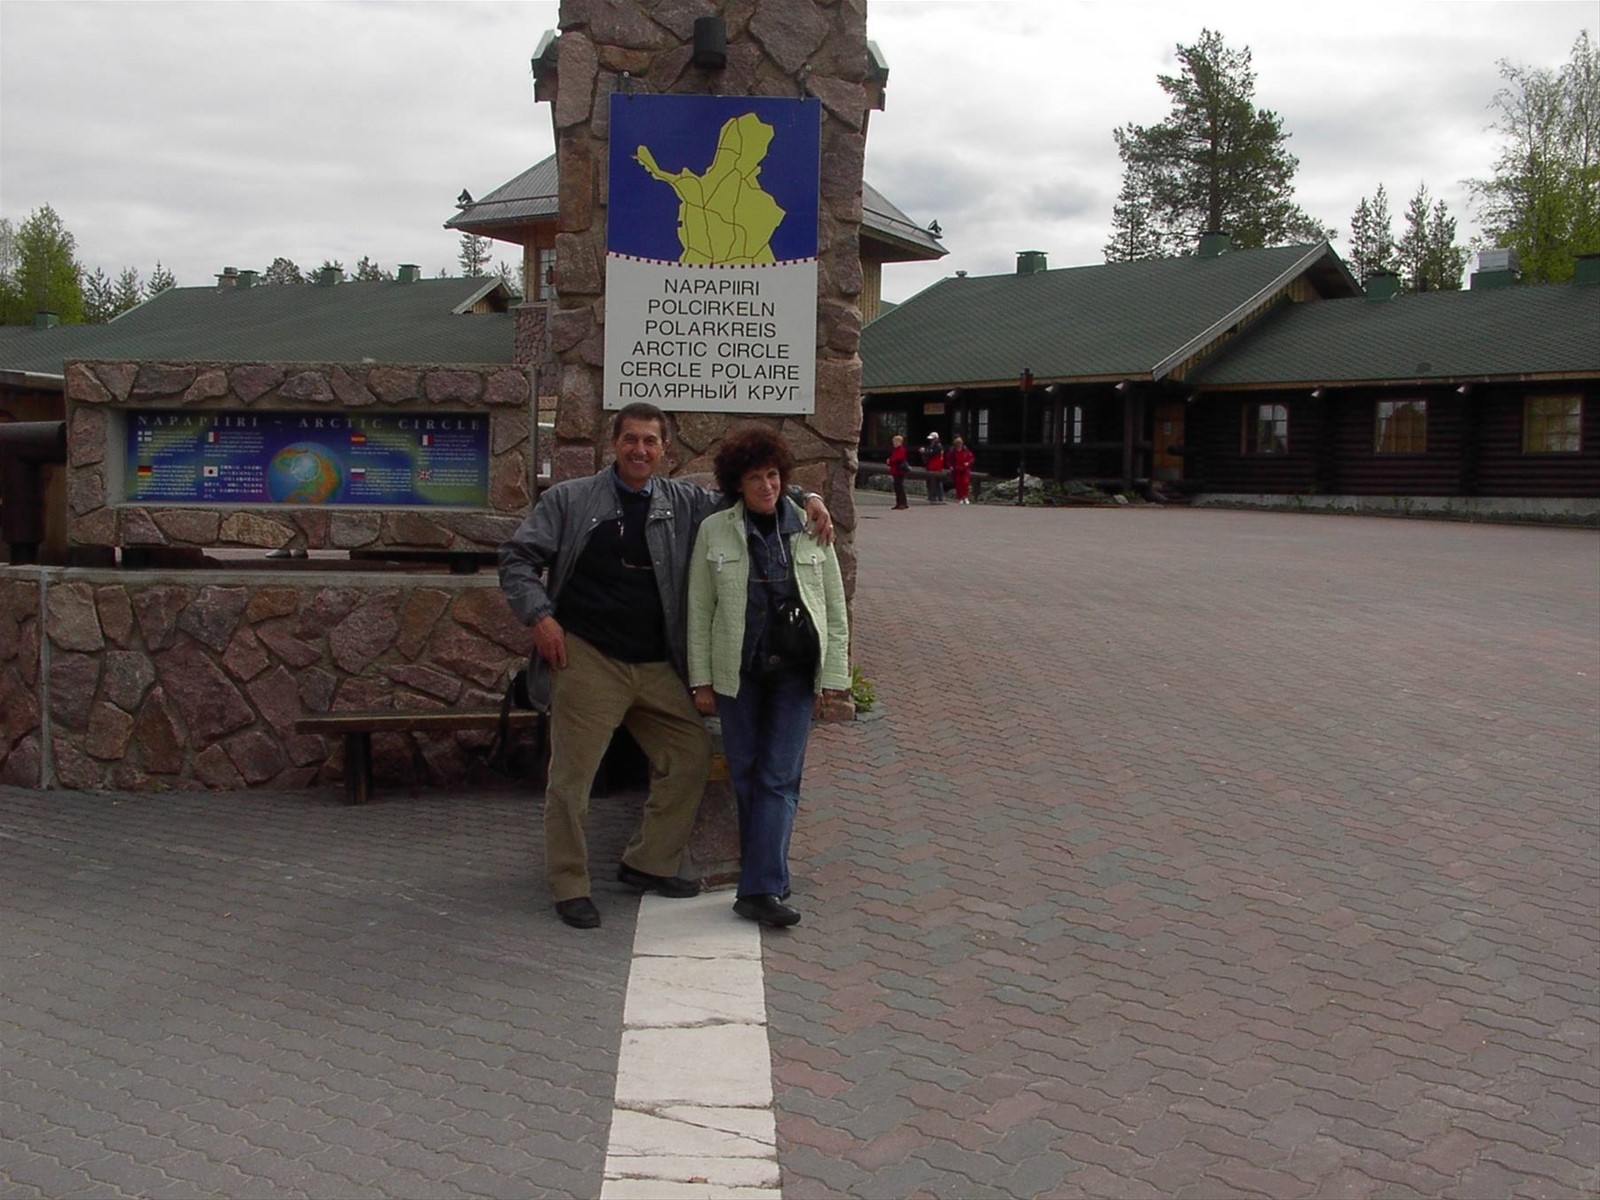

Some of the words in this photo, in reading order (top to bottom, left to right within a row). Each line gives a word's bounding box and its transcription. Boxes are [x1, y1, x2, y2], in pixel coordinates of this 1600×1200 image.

[664, 278, 760, 296] NAPAPIIRI
[648, 299, 775, 317] POLCIRKELN
[645, 320, 777, 338] POLARKREIS
[632, 341, 707, 357] ARCTIC
[717, 342, 789, 359] CIRCLE
[620, 361, 702, 378] CERCLE
[711, 363, 799, 380] POLAIRE
[619, 381, 737, 399] ПОЛЯРНЫЙ
[748, 385, 800, 401] КРУГ
[137, 415, 258, 428] NAPAPIIRI
[299, 417, 382, 429] ARCTIC
[398, 418, 480, 430] CIRCLE
